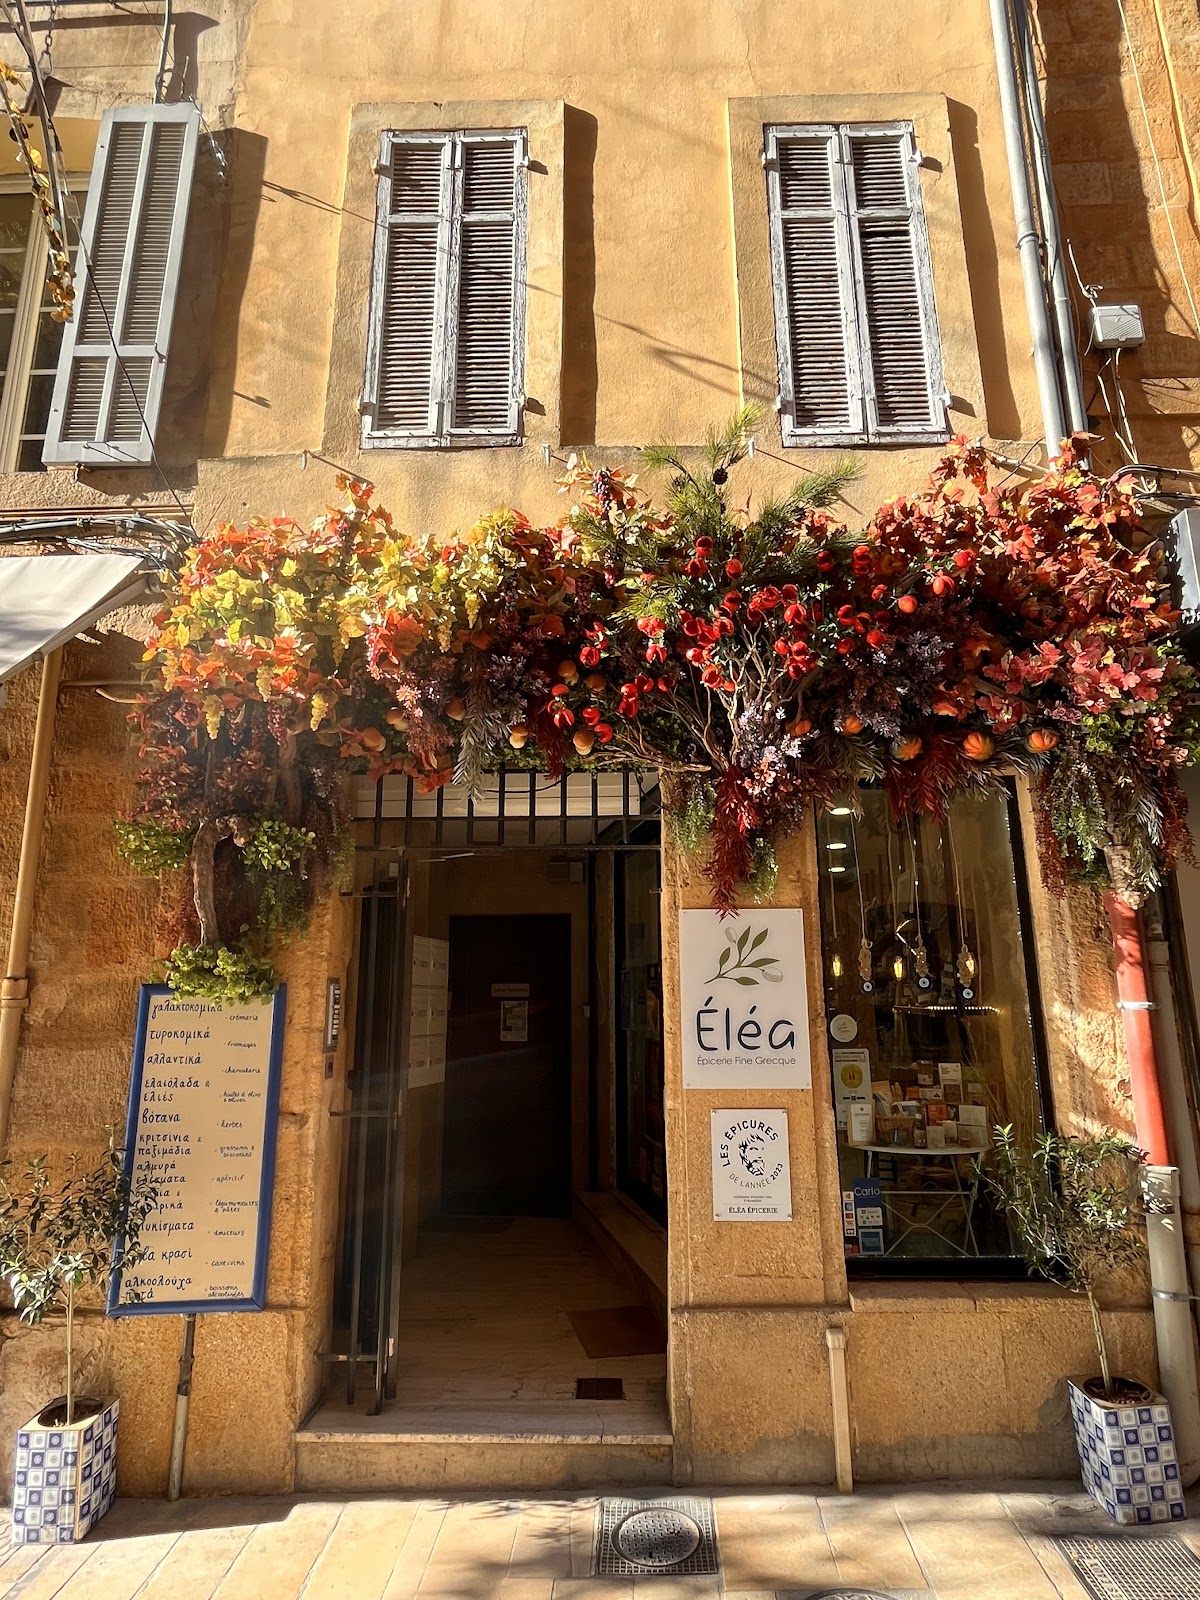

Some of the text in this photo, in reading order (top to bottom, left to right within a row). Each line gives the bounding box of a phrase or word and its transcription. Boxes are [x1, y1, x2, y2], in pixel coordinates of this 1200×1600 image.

[695, 995, 795, 1052] Éléa
[149, 1027, 210, 1045] τυροκομικά
[146, 1053, 202, 1065] αλλαντικά
[697, 1055, 796, 1067] Épicerie Fine Grecque
[143, 1091, 174, 1102] ελιές
[142, 1108, 181, 1124] βότανα
[719, 1119, 780, 1168] LES ÉPICURES
[137, 1145, 192, 1158] παξιμάδια
[728, 1172, 740, 1184] DE
[854, 1187, 881, 1196] Carlo
[747, 1206, 778, 1214] ÉPICERIE
[161, 1248, 193, 1264] κρασί
[125, 1275, 193, 1290] αλκοολούχα
